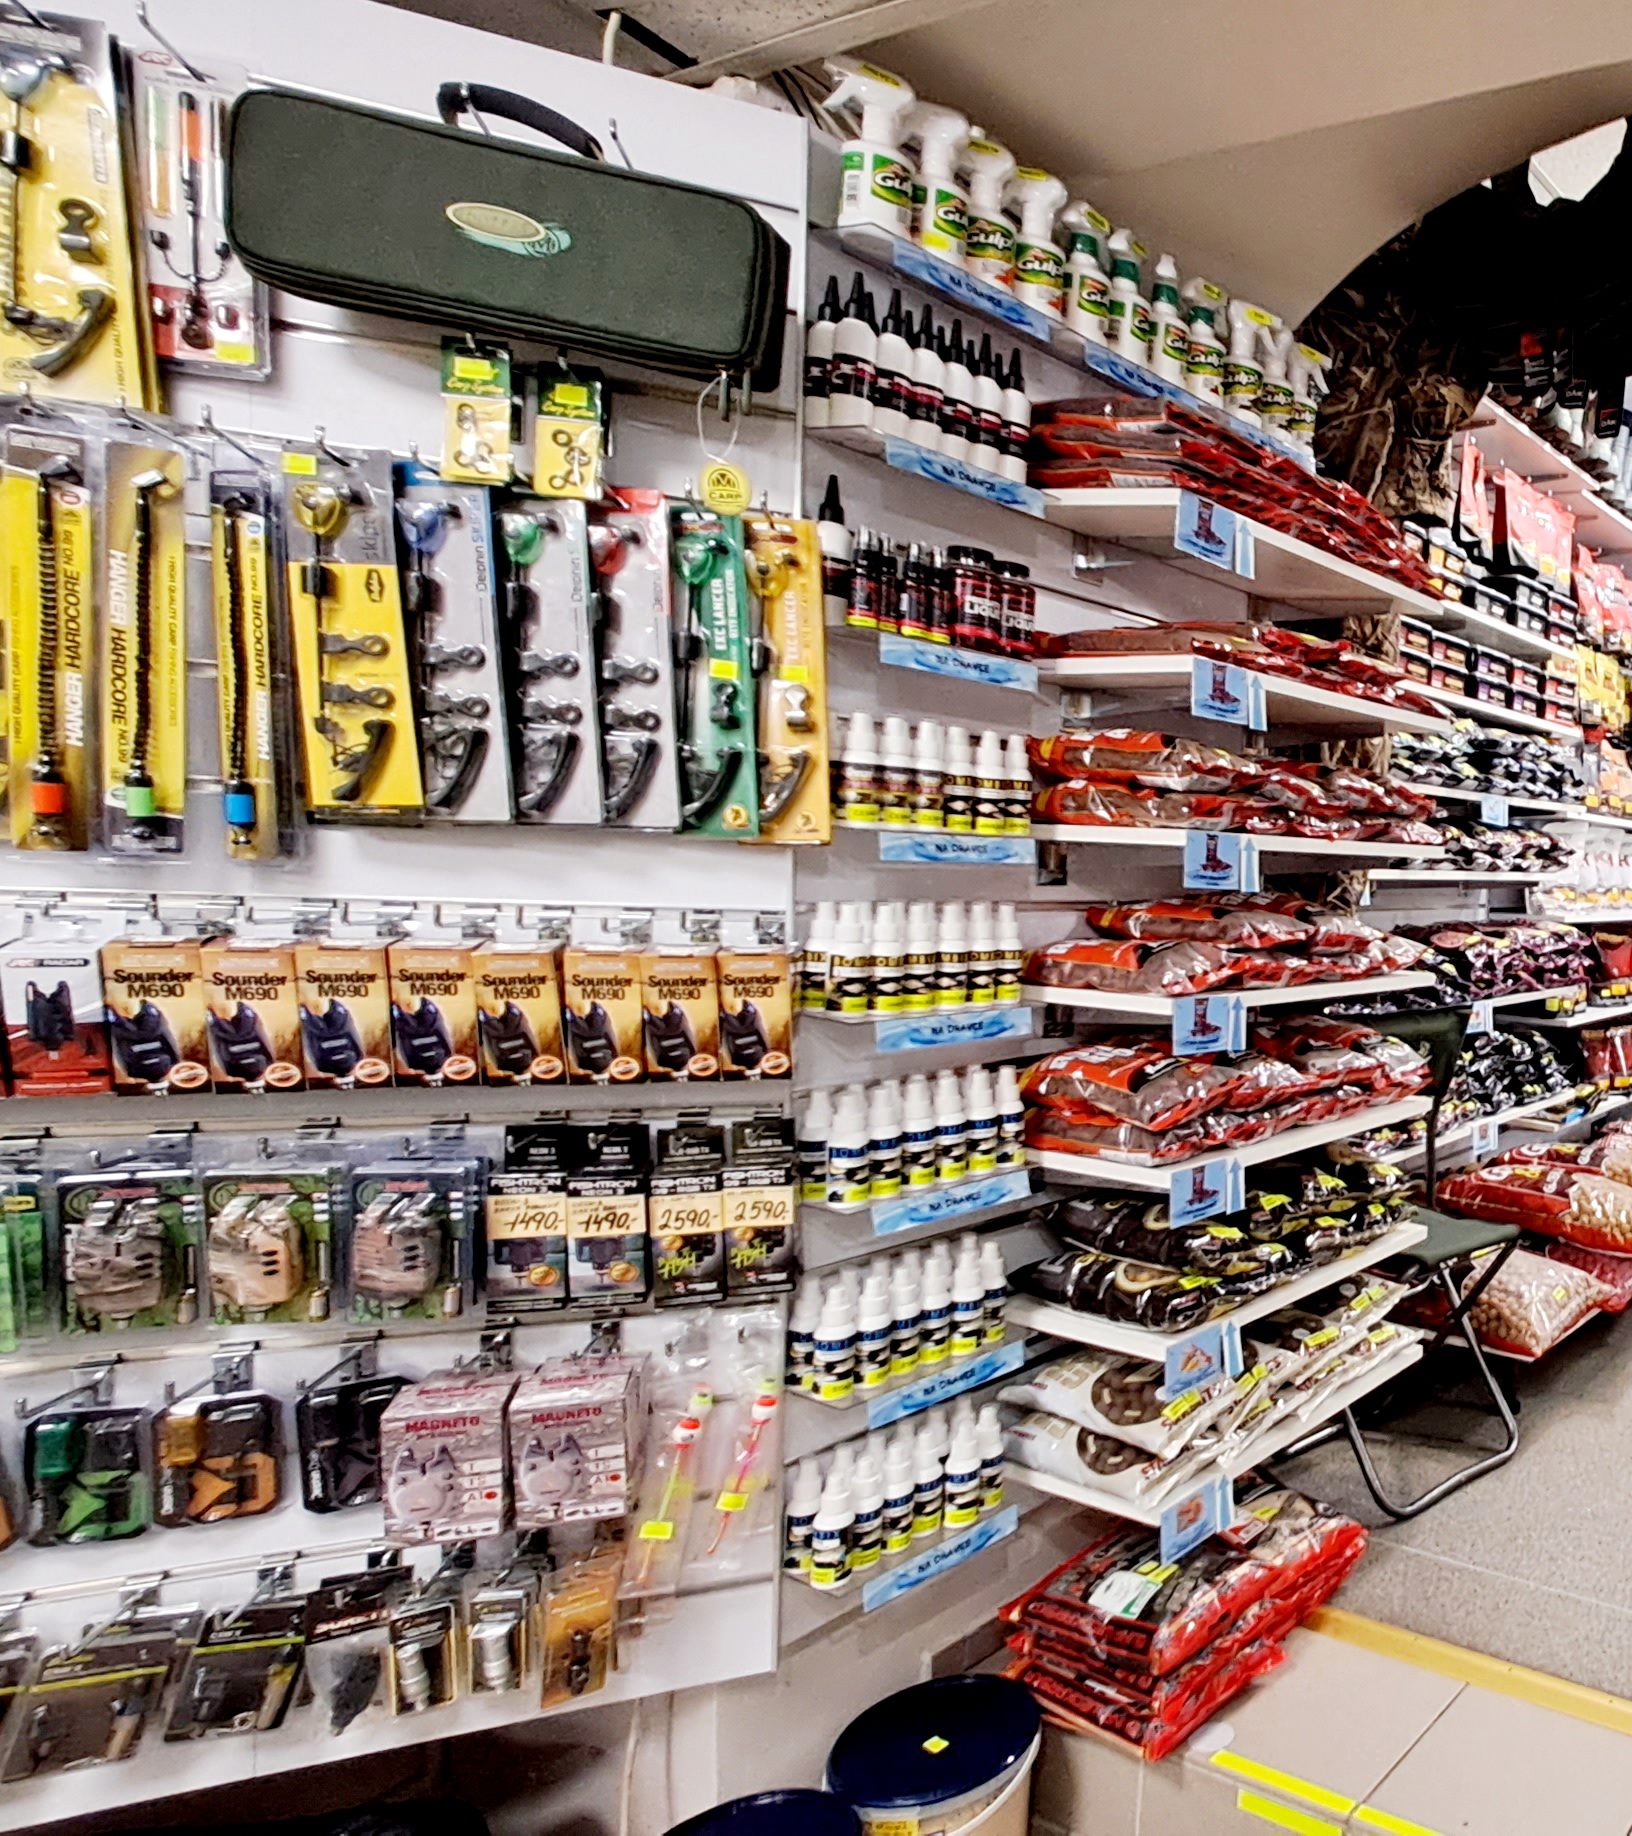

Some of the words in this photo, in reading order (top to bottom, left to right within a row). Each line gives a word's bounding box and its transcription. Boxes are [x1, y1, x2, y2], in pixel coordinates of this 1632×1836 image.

[108, 549, 128, 626] HANGER
[711, 578, 725, 622] LANCER
[62, 569, 81, 669] HARDCORE
[252, 593, 267, 687] HARDCORE
[713, 626, 726, 651] EXC
[110, 627, 127, 727] HARDCORE
[65, 672, 83, 747] HANGER
[255, 691, 270, 760] HANGER
[113, 969, 194, 984] Sounder
[211, 973, 288, 987] Sounder
[305, 970, 377, 984] Sounder
[399, 969, 466, 983] Sounder
[482, 974, 547, 987] Sounder
[571, 975, 634, 987] Sounder
[648, 976, 708, 987] Sounder
[723, 974, 781, 986] Sounder
[127, 984, 185, 999] M690
[225, 986, 279, 1001] M690
[317, 985, 370, 998] M690
[410, 983, 459, 996] M690
[493, 985, 541, 1000] M690
[581, 987, 625, 1000] M690
[658, 987, 701, 1000] M690
[733, 985, 774, 998] M690
[490, 1178, 561, 1188] FISHTRON
[568, 1180, 638, 1190] FISHTRON
[405, 1416, 480, 1432] MAGNETO
